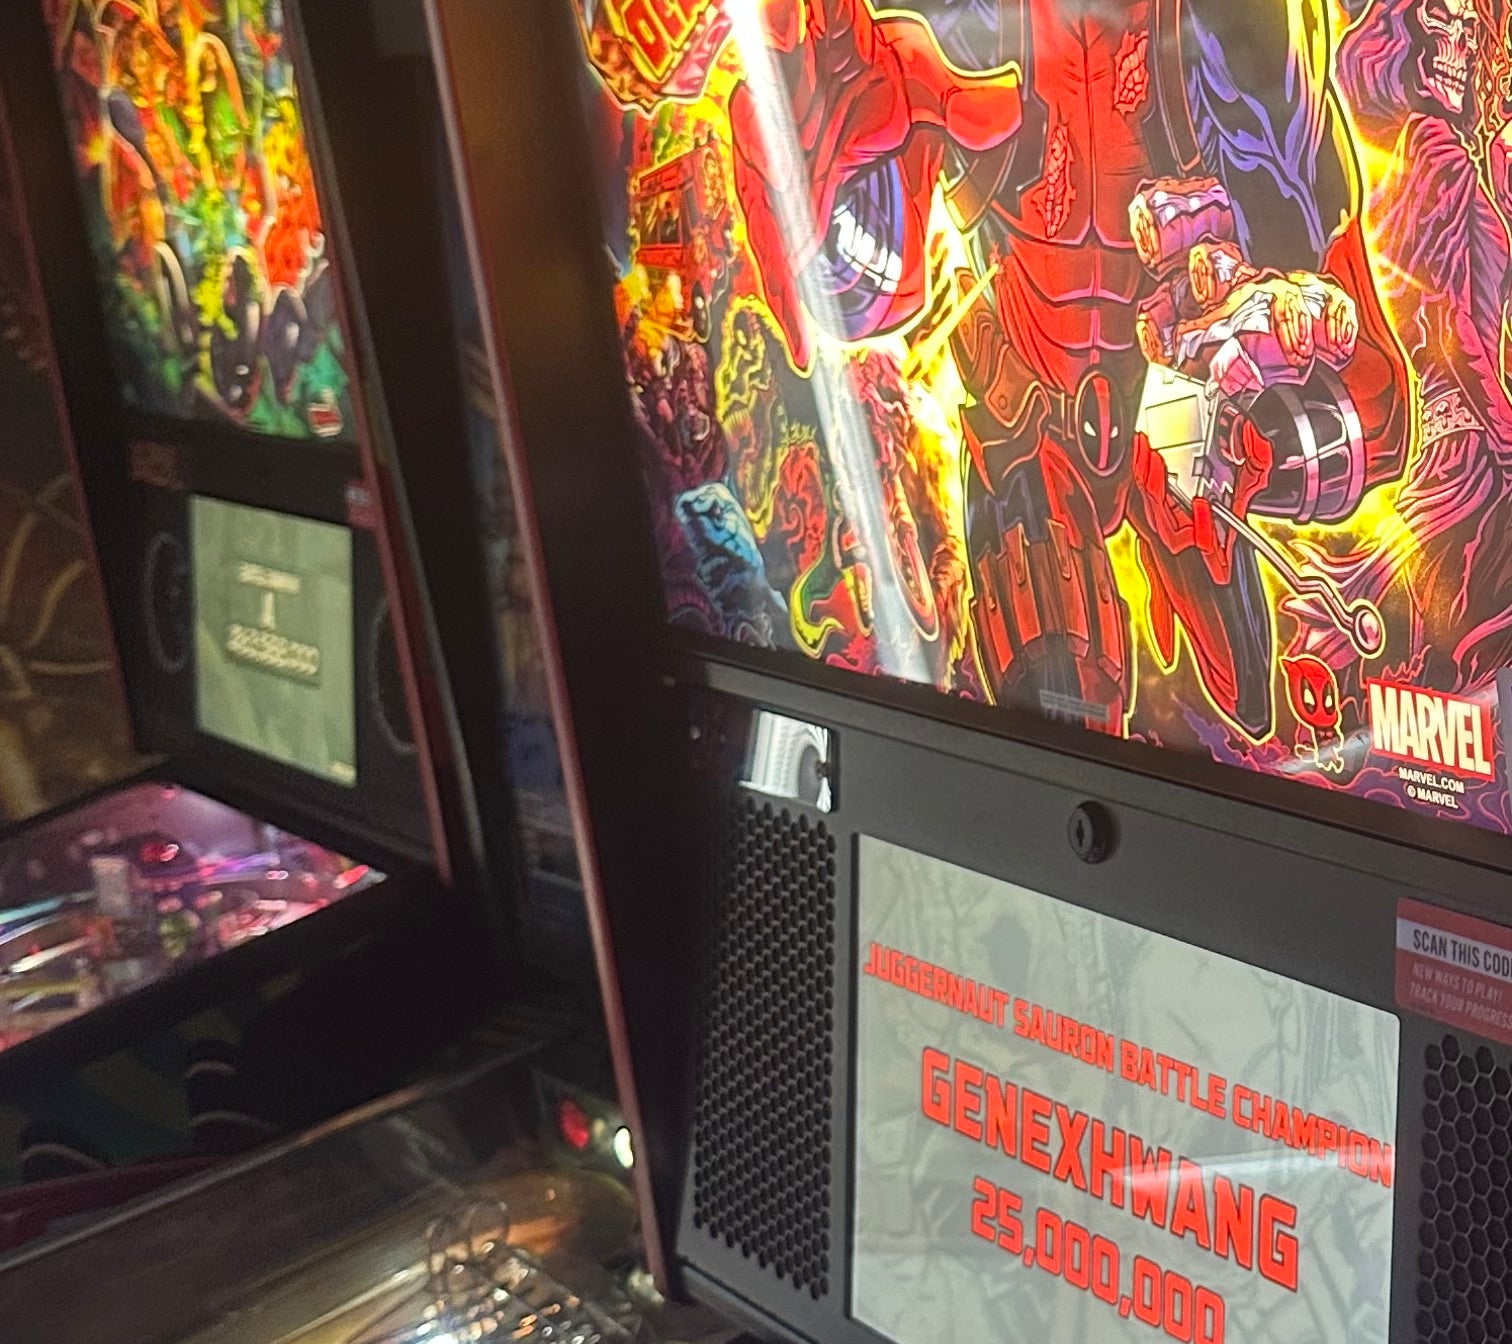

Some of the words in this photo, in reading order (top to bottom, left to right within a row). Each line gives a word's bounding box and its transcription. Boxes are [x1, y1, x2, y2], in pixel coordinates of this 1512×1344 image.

[1368, 682, 1492, 776] MARVEL
[1398, 766, 1465, 795] MARVEL.COM
[1416, 787, 1459, 809] MARVEL
[1412, 928, 1448, 958] SCAN
[1450, 939, 1481, 969] THIS
[1410, 982, 1440, 1006] TRACK
[1440, 993, 1465, 1014] YOUR
[1411, 962, 1434, 980] NEW
[1435, 968, 1460, 989] WAYS
[1461, 977, 1475, 994] TO
[1474, 980, 1503, 1005] PLAY!
[863, 941, 1011, 1031] JUGGERNAUT
[1013, 998, 1116, 1074] SAURON
[1120, 1039, 1227, 1120] BATTLE
[1231, 1083, 1394, 1189] CHAMPION
[919, 1045, 1300, 1293] GENEXHWANG
